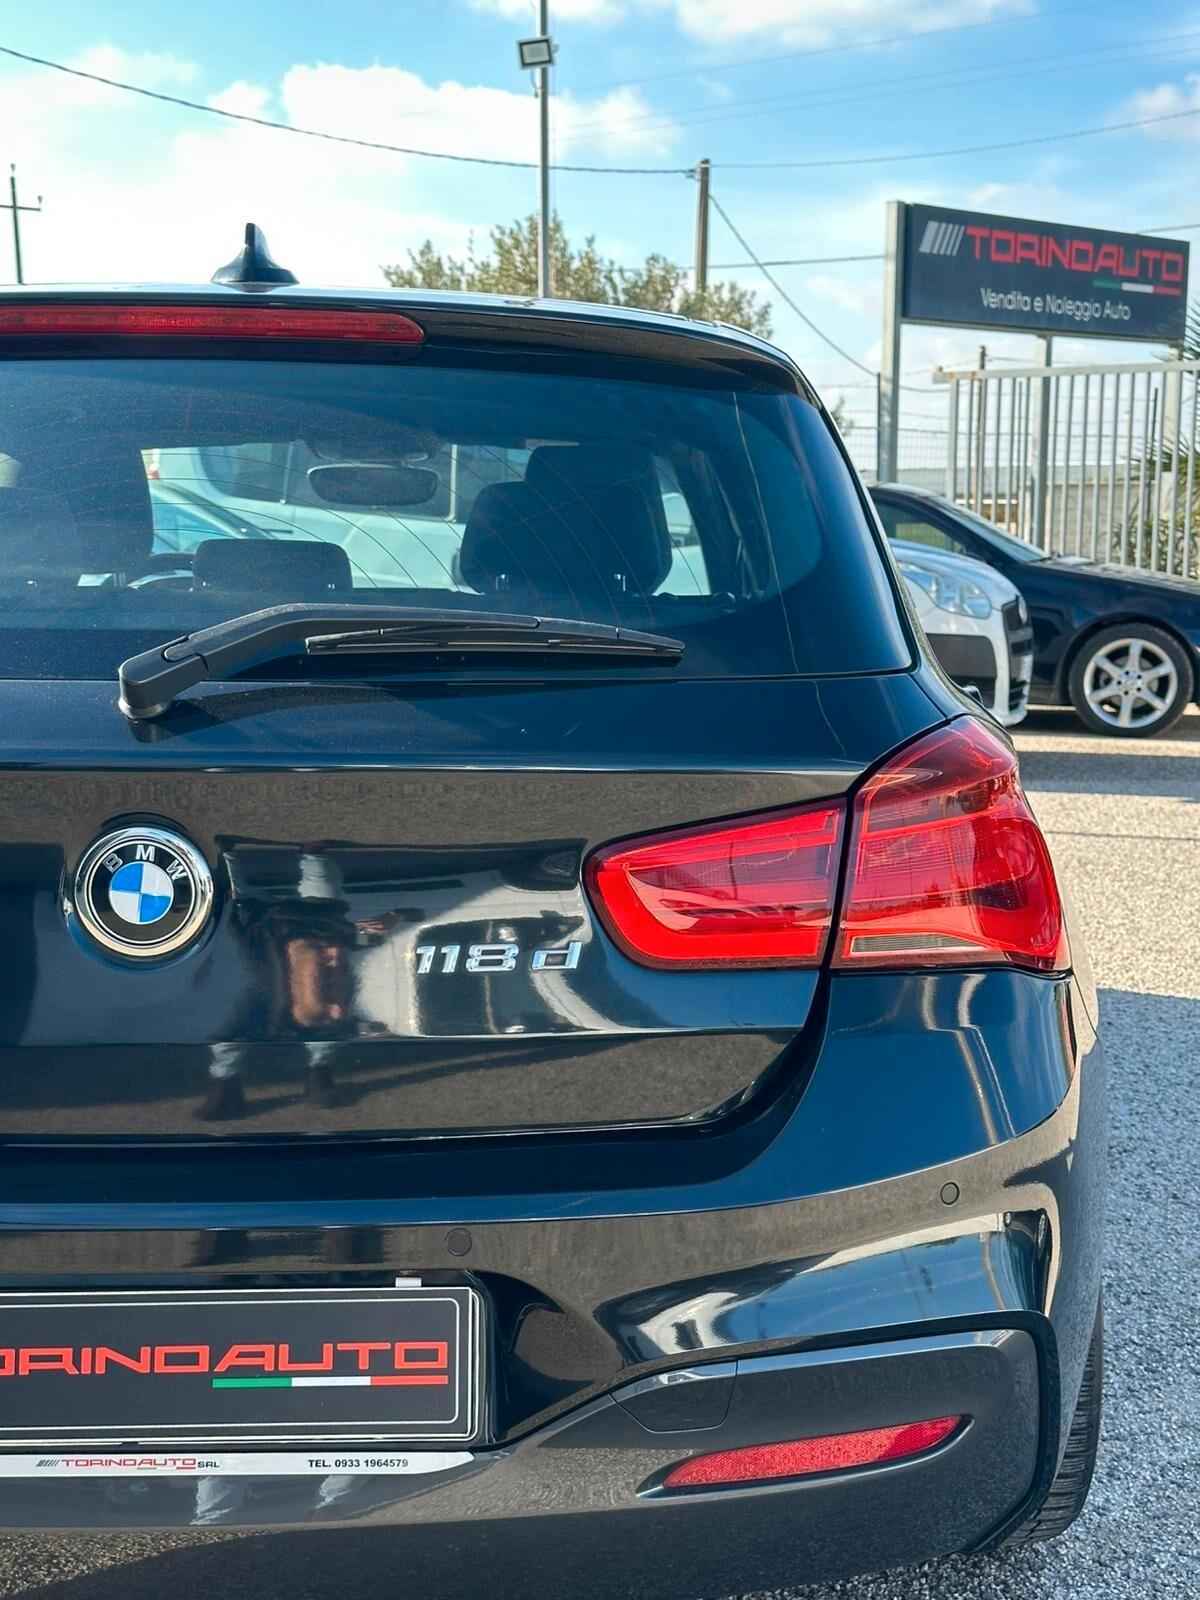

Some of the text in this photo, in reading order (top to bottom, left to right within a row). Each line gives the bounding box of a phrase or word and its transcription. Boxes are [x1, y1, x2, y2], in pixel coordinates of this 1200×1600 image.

[966, 226, 1184, 282] TORINOAUTO
[980, 287, 1131, 321] Vendita e Noleggio Auto
[104, 844, 188, 881] BMW
[0, 1341, 448, 1376] RINOAUTO
[62, 1458, 220, 1468] TORINOAUTO SRL
[308, 1458, 409, 1468] TEL. 0933 1964579
